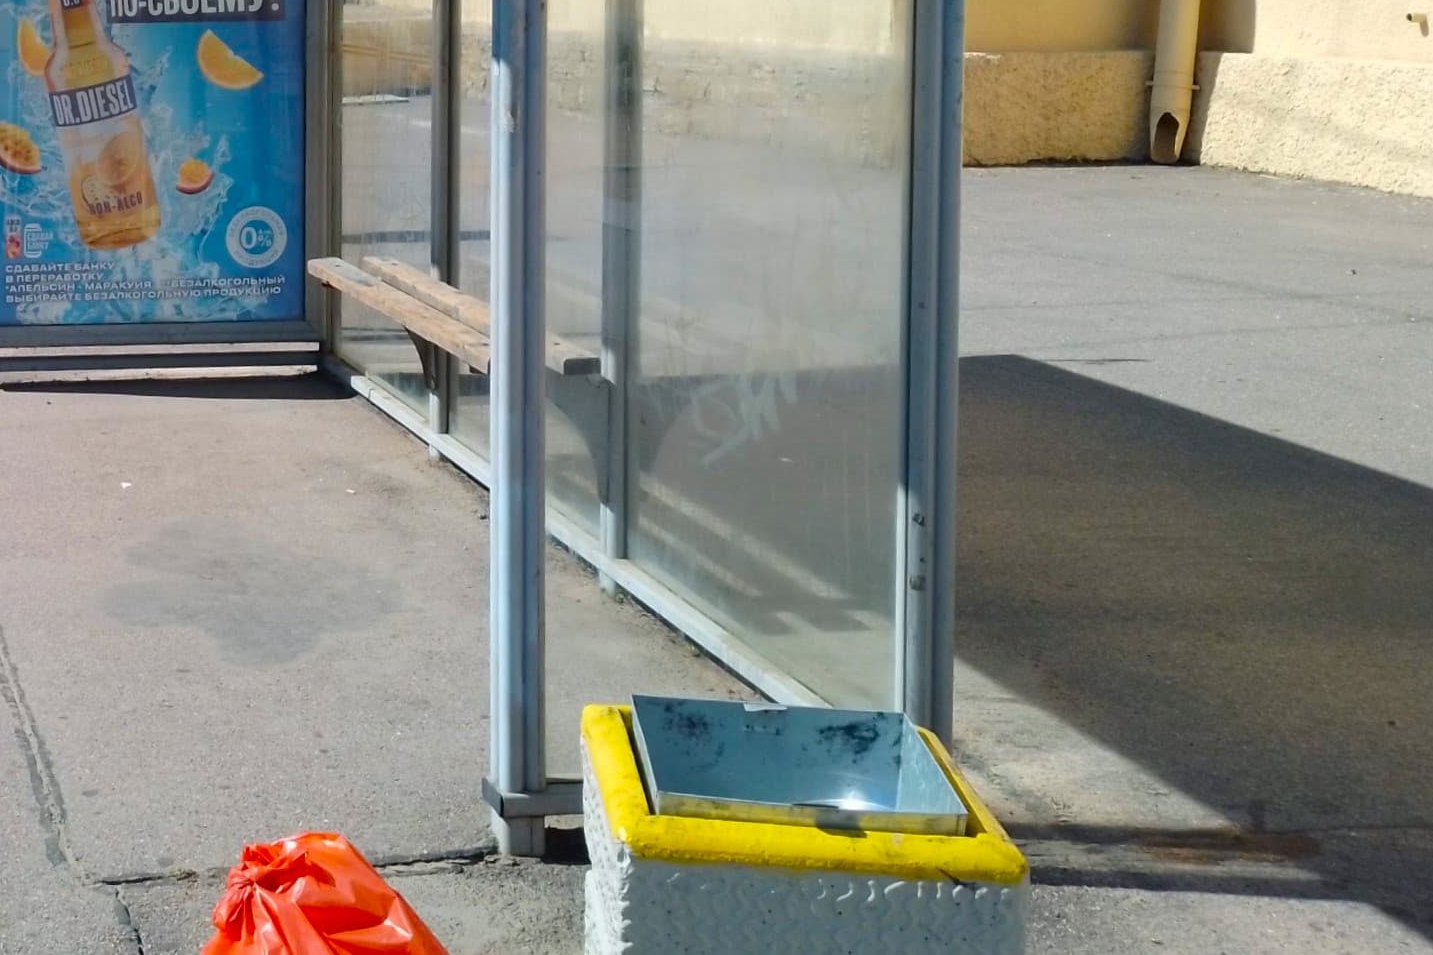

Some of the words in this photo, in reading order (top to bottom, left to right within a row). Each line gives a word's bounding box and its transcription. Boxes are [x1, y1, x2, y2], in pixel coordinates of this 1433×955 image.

[53, 78, 134, 125] DR.DIESEL
[88, 191, 143, 215] NON-ALCO
[5, 262, 72, 273] СДАВАЙТЕ
[74, 262, 114, 271] БАНКУ
[5, 275, 13, 283] В
[16, 272, 104, 283] ПЕРЕРАБОТКУ
[172, 274, 286, 288] БЕЗАЛКОГОЛЬНЫЙ
[5, 292, 82, 303] ВЫБИРАЙТЕ
[85, 289, 201, 302] БЕЗАЛКОГОЛЬНУЮ
[204, 286, 281, 297] ПРОДУКЦИЮ
